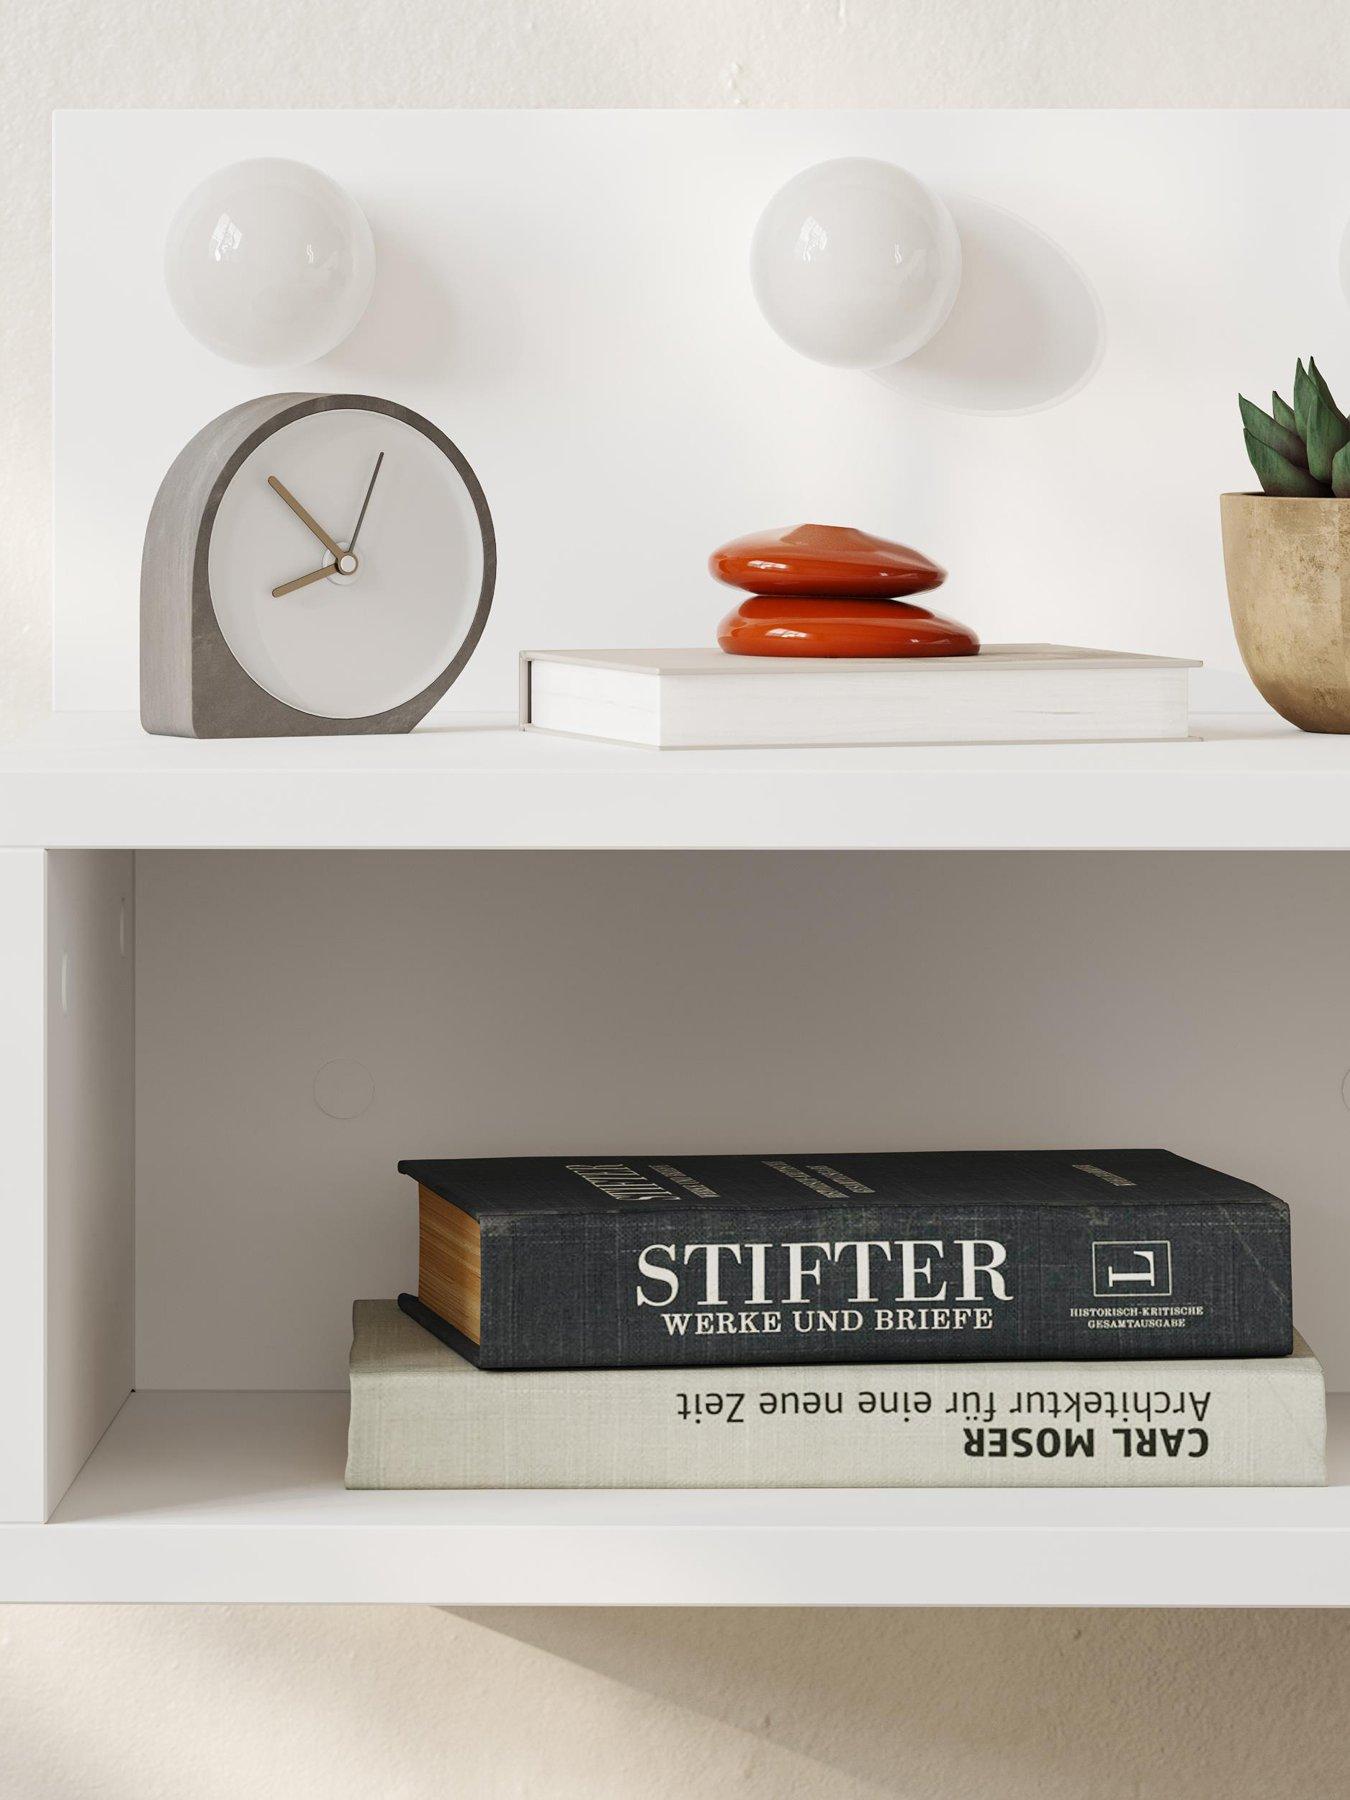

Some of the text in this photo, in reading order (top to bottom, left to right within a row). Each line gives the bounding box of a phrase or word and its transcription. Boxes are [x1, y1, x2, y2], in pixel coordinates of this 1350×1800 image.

[636, 1239, 1014, 1307] STIFTER
[661, 1307, 993, 1336] WERKE UND BRIEFE
[1069, 1306, 1204, 1317] HISTORISCH-KRITISCHE
[1087, 1318, 1186, 1329] GESAMTAUSGABE
[677, 1391, 1212, 1424] Architektur für eine neue Zeit
[963, 1427, 1209, 1458] CARL MOSER
